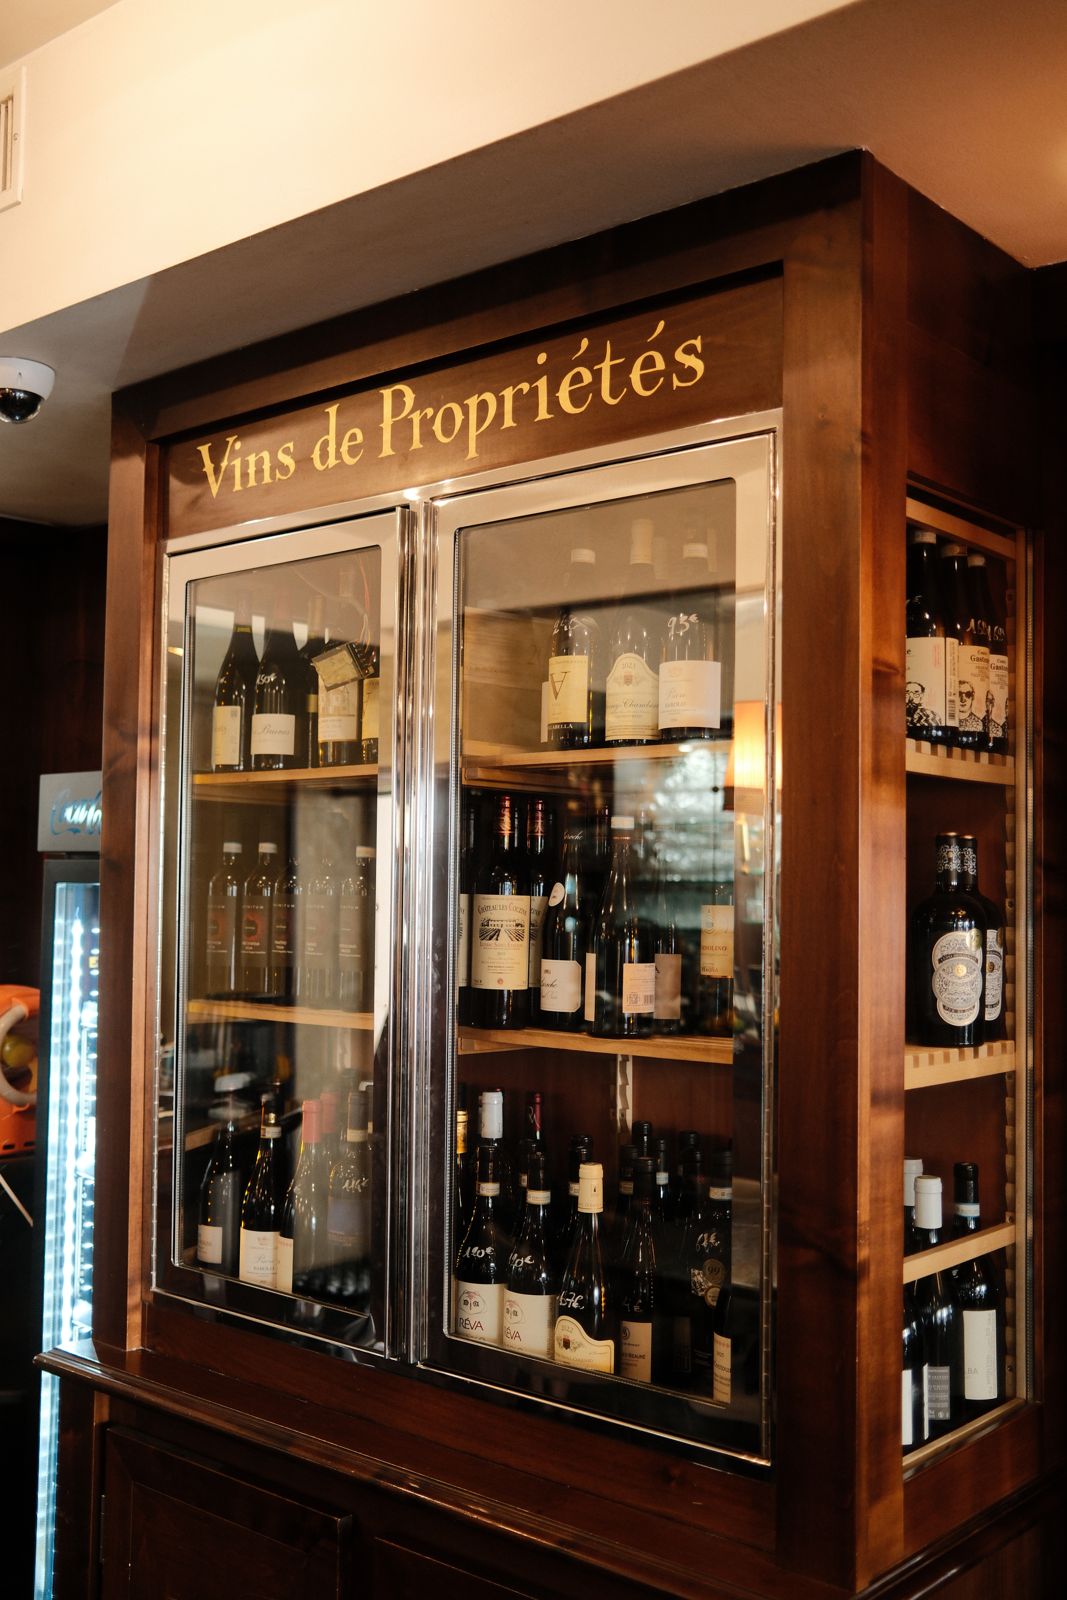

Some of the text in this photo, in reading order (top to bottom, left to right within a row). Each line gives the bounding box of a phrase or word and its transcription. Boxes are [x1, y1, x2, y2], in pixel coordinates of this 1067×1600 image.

[196, 319, 706, 499] Vins de Propriétés
[459, 1317, 484, 1332] RÉVA
[503, 1326, 522, 1342] ÉVA
